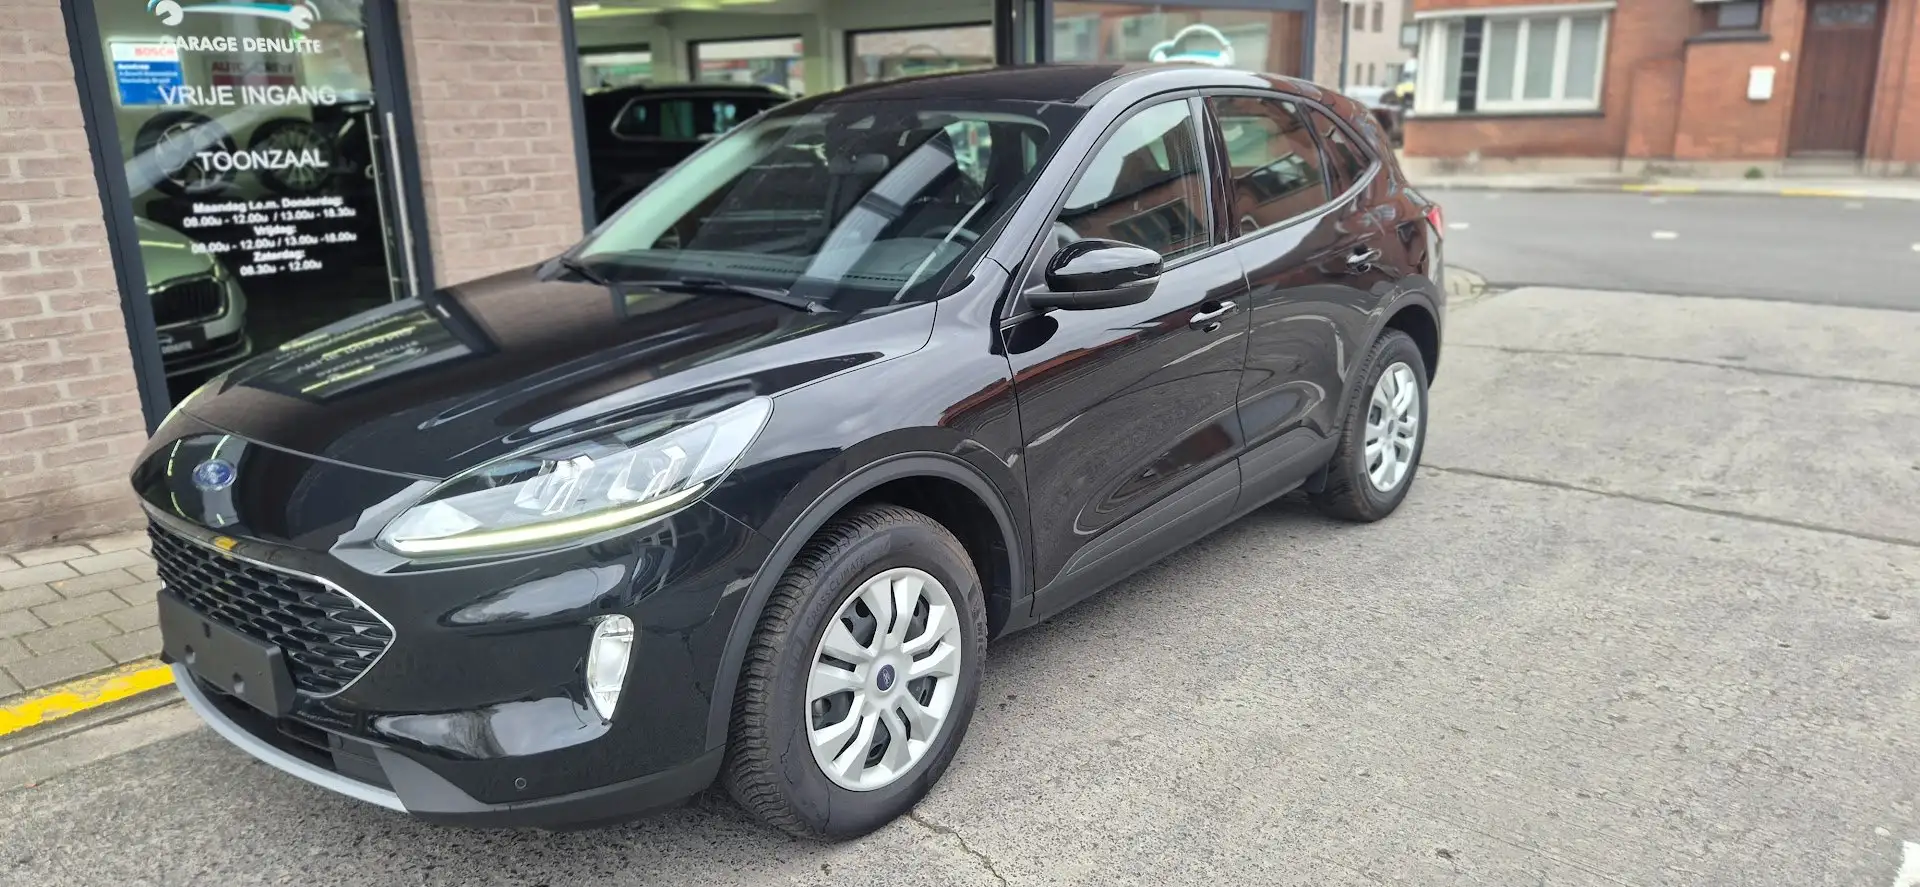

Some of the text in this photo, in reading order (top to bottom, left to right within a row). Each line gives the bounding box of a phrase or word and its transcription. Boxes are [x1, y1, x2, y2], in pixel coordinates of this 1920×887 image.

[160, 35, 322, 54] GARAGE DENUTTE
[157, 85, 337, 106] VRIJE INGANG
[196, 148, 329, 171] TOONZAAL
[192, 202, 248, 214] Maandag
[281, 195, 344, 209] Donderdag:
[183, 215, 223, 229] 08.00u
[232, 212, 269, 225] 12.00u
[280, 208, 316, 221] 13.00u
[323, 206, 357, 218] 18.30u
[240, 238, 276, 250] 12.00u
[284, 233, 319, 246] 13.00u
[288, 259, 323, 272] 12.00u
